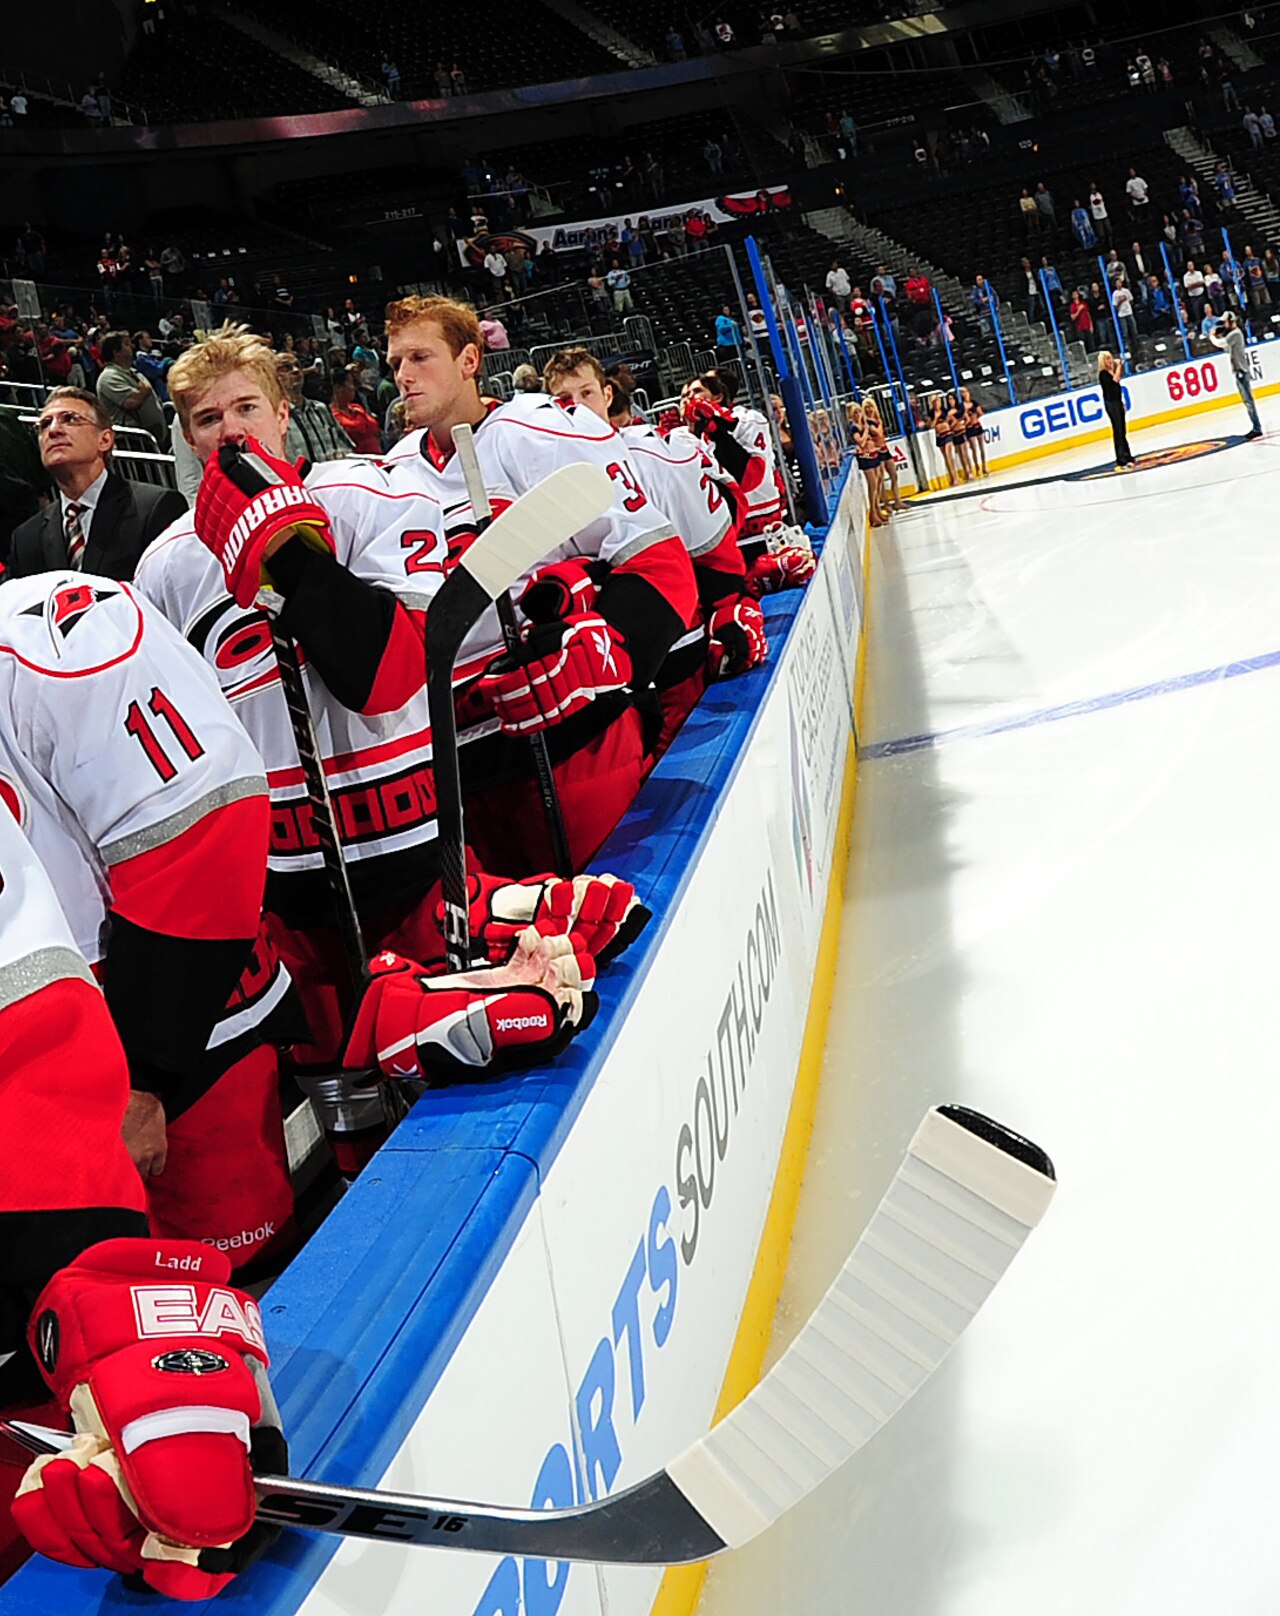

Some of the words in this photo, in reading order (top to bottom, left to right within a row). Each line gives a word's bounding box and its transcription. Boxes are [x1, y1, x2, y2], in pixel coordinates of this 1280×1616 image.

[554, 224, 618, 248] Aaron's
[1167, 362, 1218, 400] 680
[754, 432, 767, 450] 4
[124, 686, 205, 784] 11
[496, 1015, 548, 1032] Reebok
[154, 1251, 203, 1272] Ladd
[432, 1515, 468, 1533] 16
